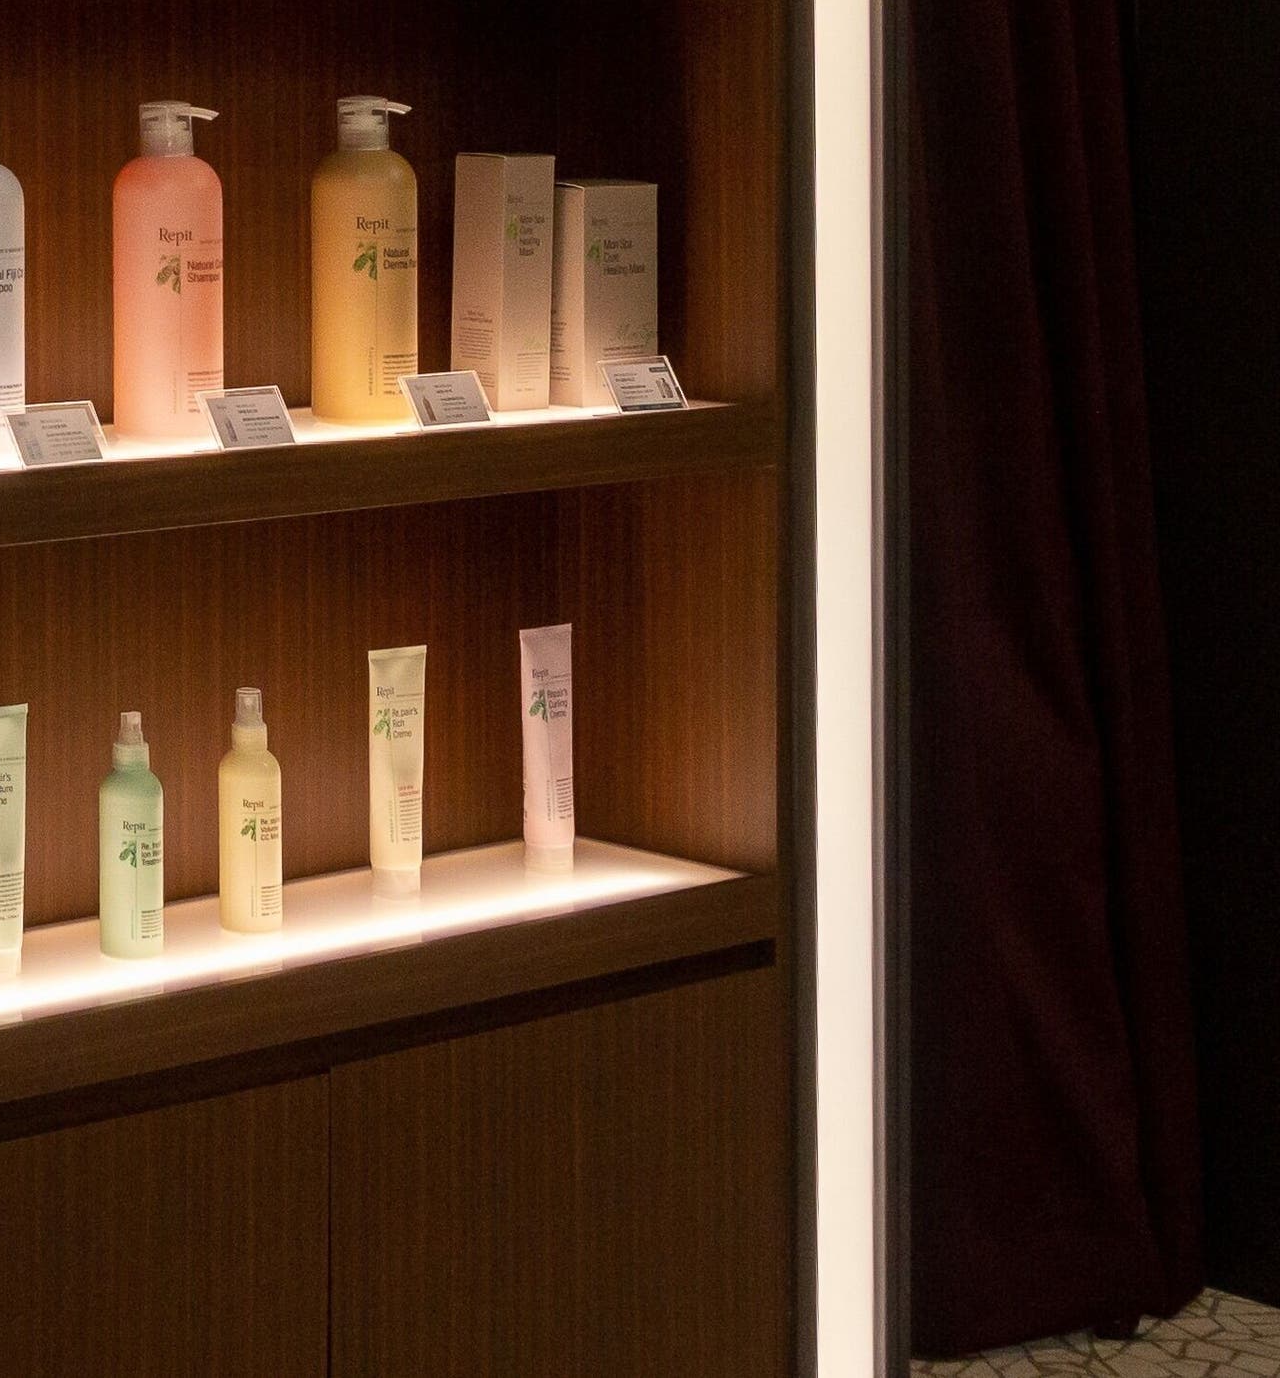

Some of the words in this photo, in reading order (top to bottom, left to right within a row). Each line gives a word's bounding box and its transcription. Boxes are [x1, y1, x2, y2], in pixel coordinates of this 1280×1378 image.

[356, 216, 390, 235] Repit
[159, 226, 193, 247] Repit
[383, 246, 410, 257] Natural
[187, 260, 214, 270] Natural
[122, 820, 146, 834] Repit
